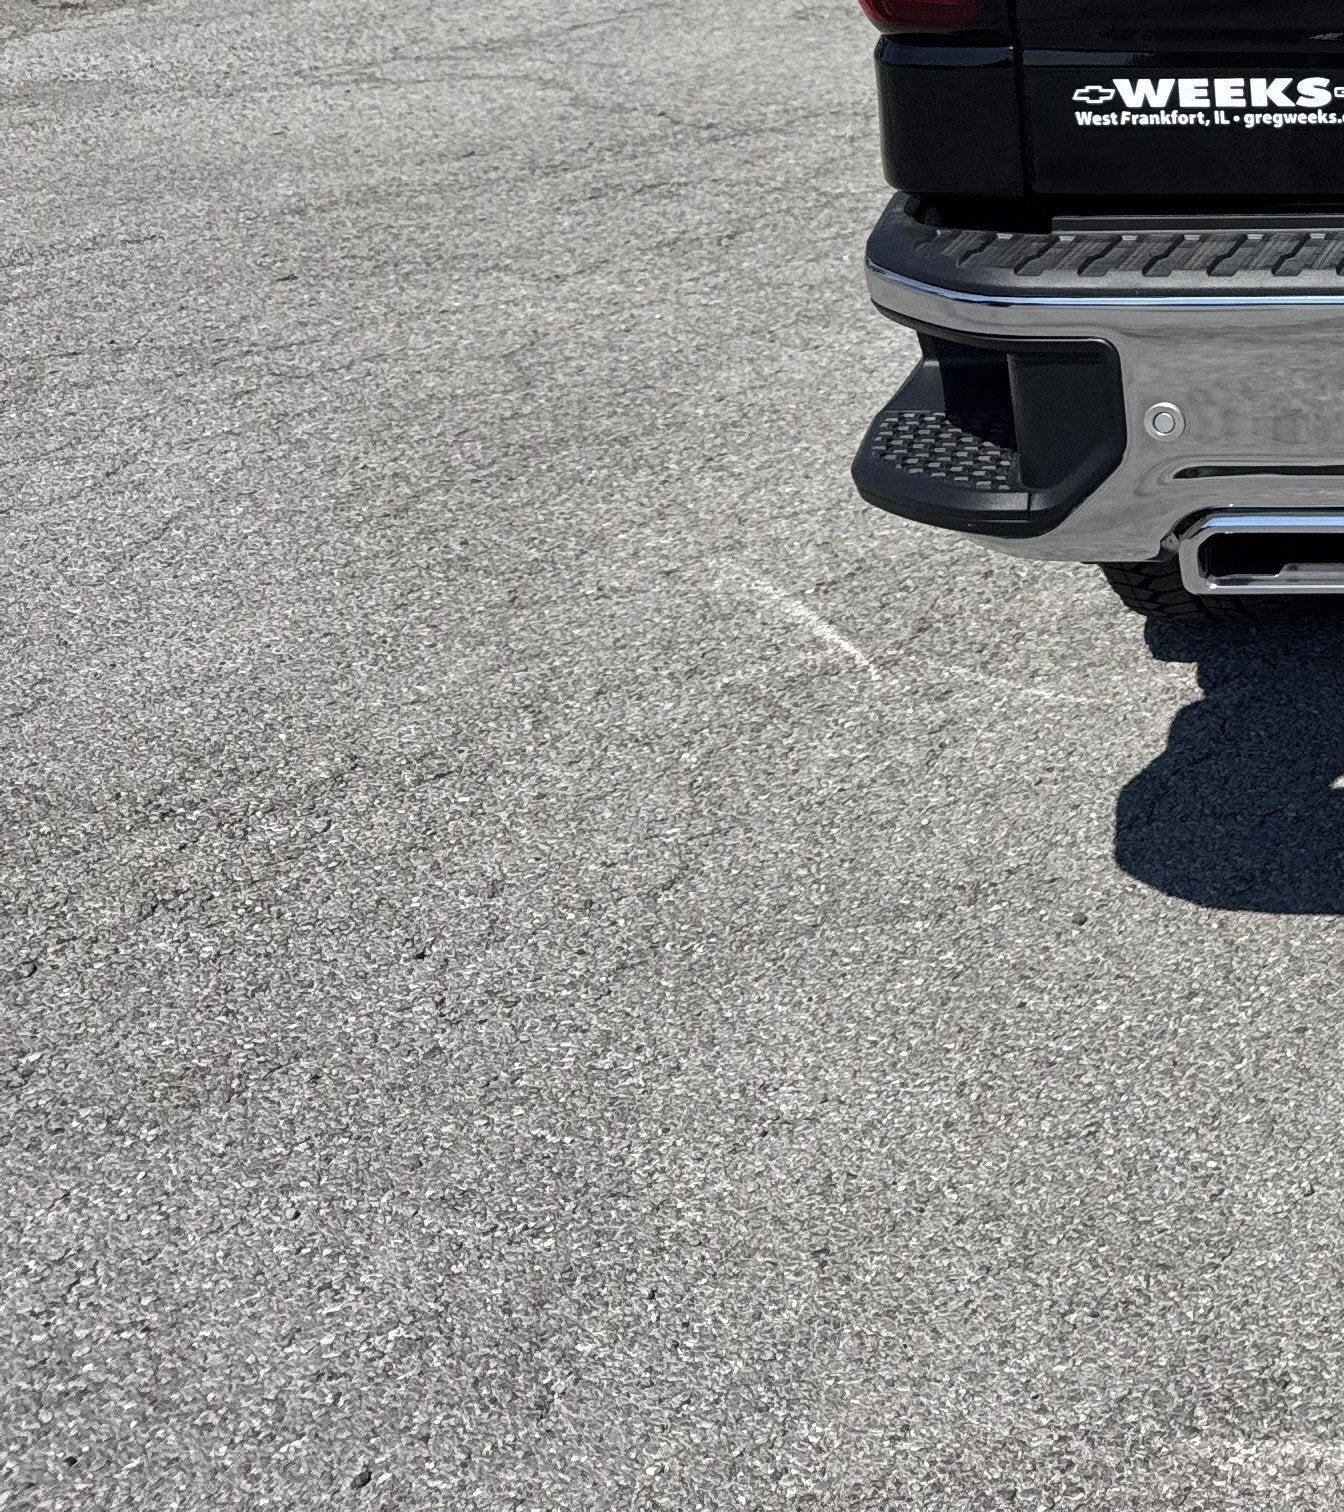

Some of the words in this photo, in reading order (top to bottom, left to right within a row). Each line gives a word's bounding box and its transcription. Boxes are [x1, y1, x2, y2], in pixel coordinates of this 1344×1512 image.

[1112, 76, 1332, 108] WEEKS
[1074, 110, 1119, 126] West
[1119, 110, 1211, 127] Frankfort,
[1213, 109, 1231, 125] IL
